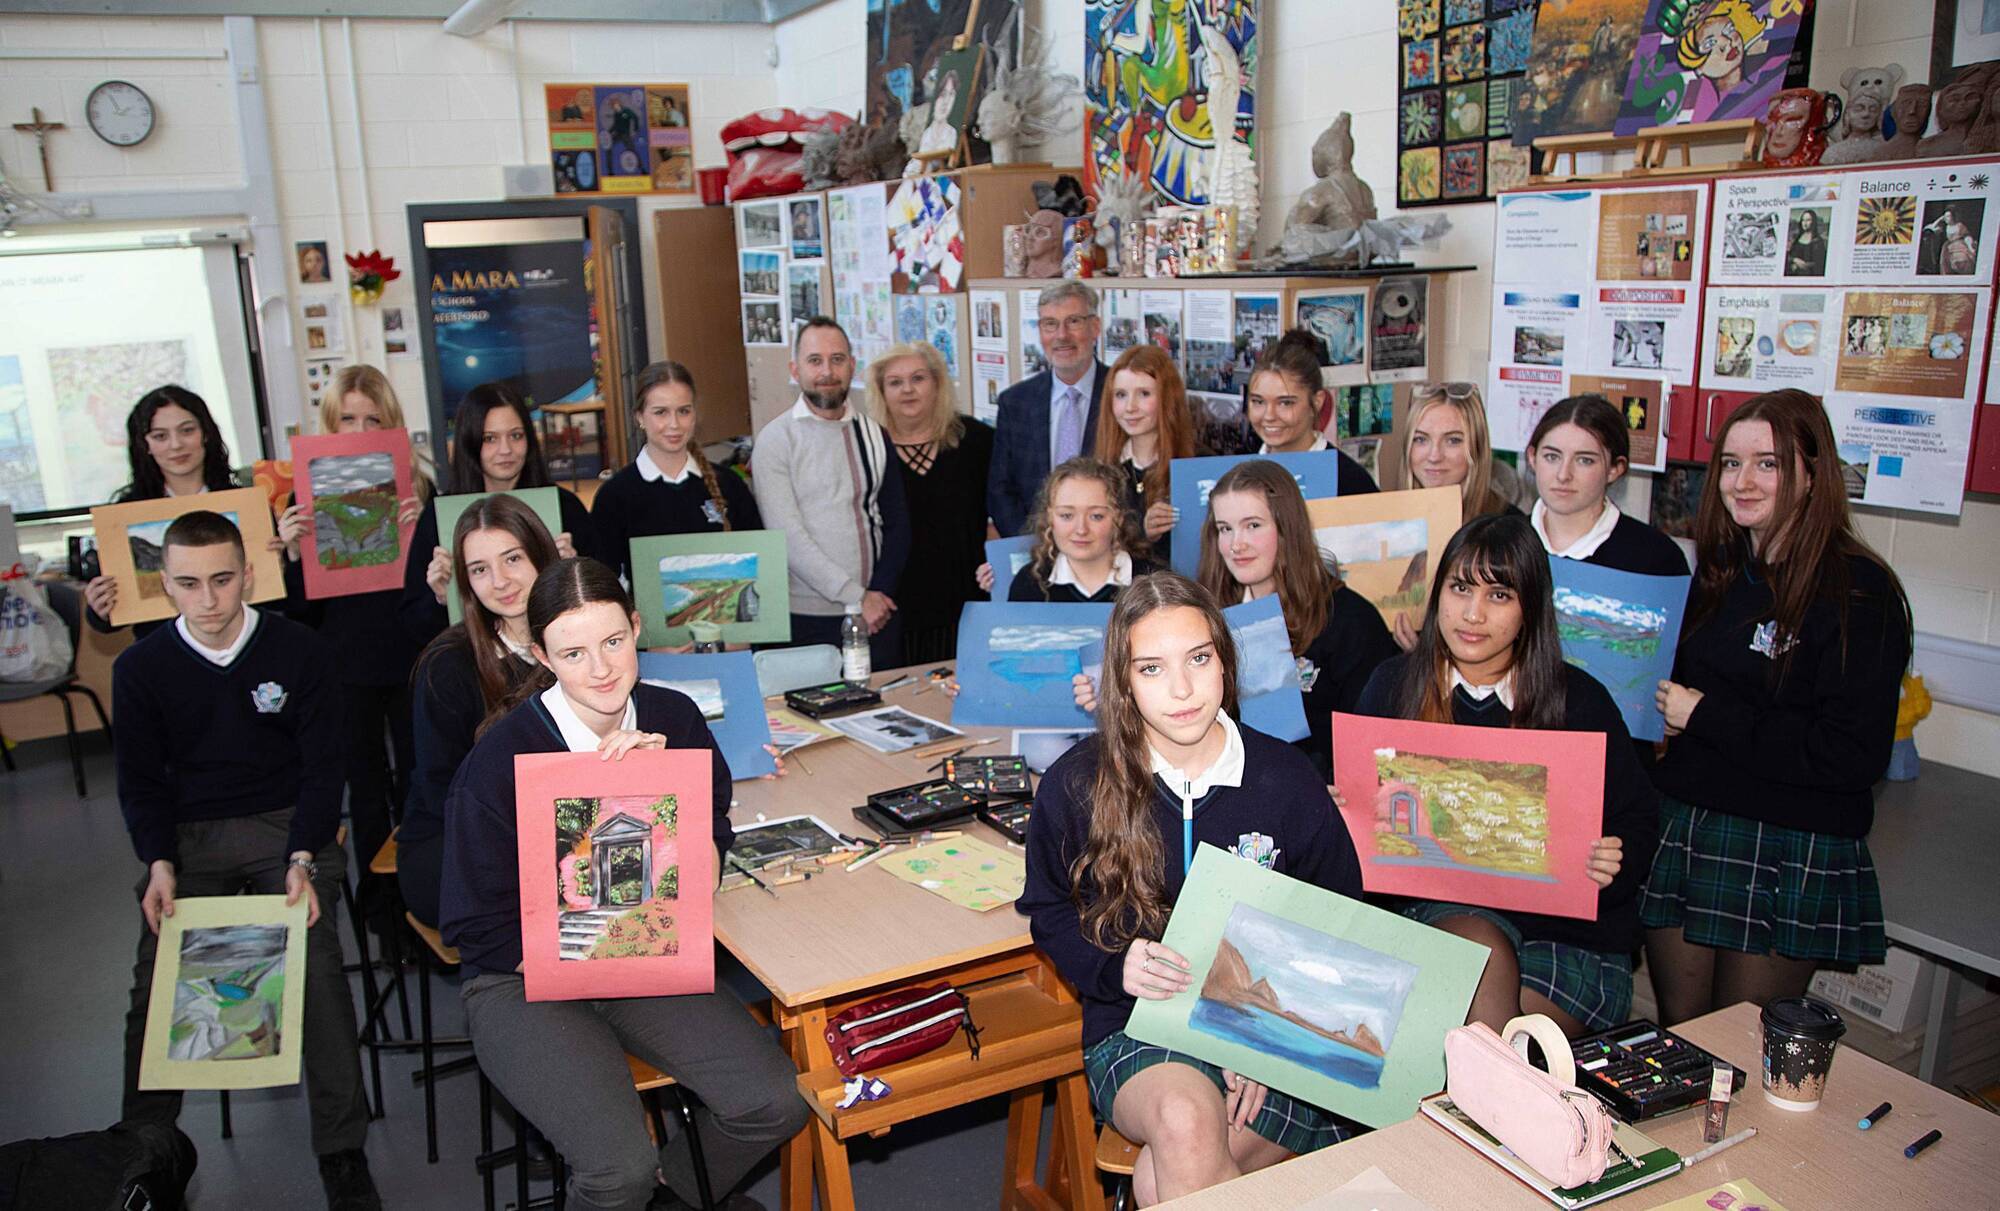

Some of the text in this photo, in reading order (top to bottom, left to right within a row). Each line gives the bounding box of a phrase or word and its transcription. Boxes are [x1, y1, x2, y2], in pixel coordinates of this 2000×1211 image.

[1729, 185, 1757, 195] Space
[1860, 181, 1911, 193] Balance
[452, 270, 520, 290] MARA
[1610, 288, 1675, 301] COMPOSITION
[1719, 296, 1770, 309] Emphasis
[1854, 408, 1936, 426] PERSPECTIVE
